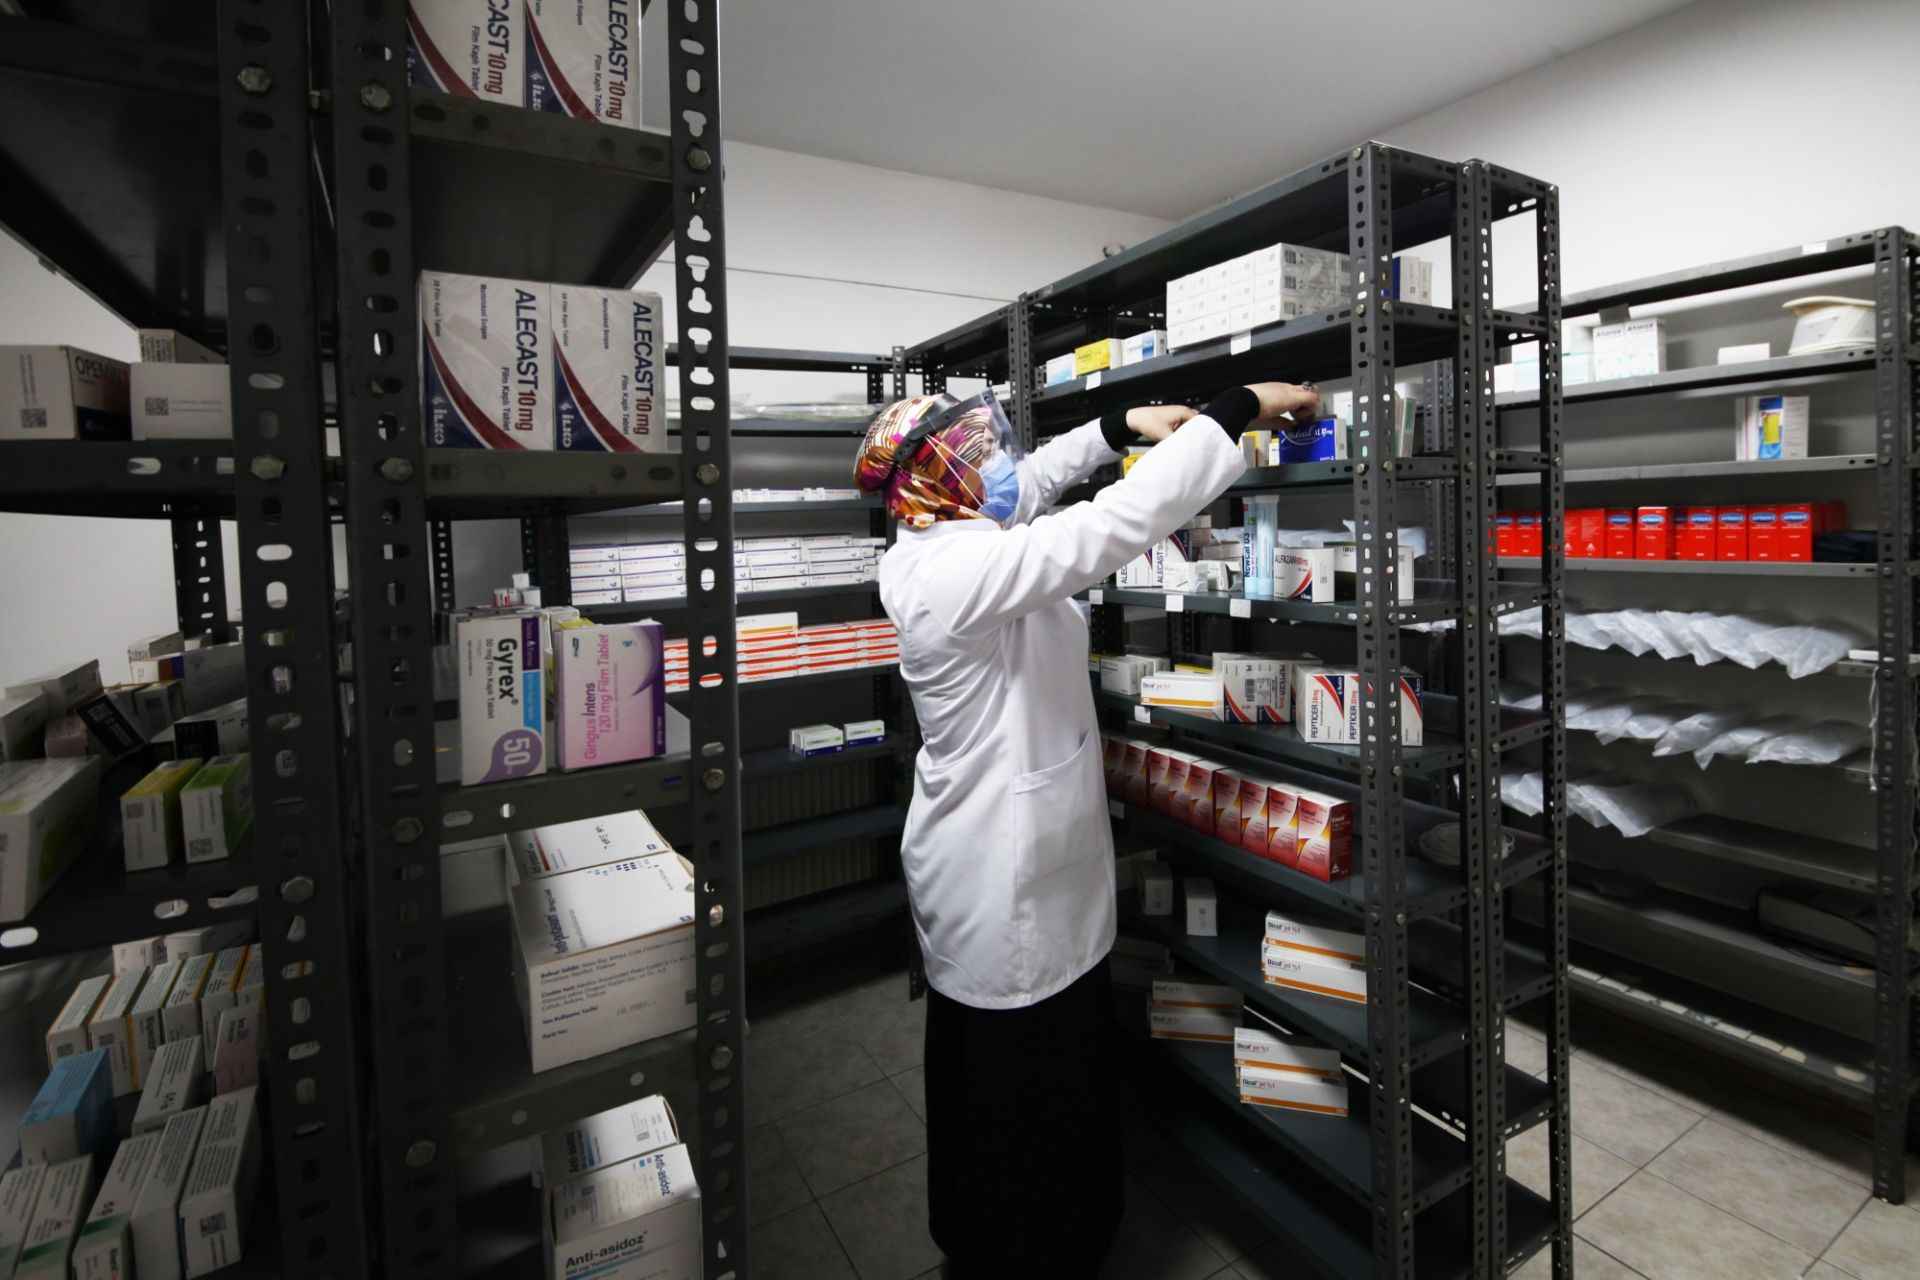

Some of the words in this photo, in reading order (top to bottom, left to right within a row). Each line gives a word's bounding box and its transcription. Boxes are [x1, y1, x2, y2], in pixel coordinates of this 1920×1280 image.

[514, 288, 538, 390] ALECAST
[632, 301, 654, 396] ALECAST
[501, 366, 510, 383] Film
[501, 406, 511, 431] Tablet
[596, 634, 610, 666] Tablet
[493, 638, 518, 700] Gyrex
[598, 668, 609, 694] Film
[580, 682, 597, 717] Intens
[599, 694, 613, 714] mg
[503, 736, 531, 767] 50
[565, 1233, 646, 1268] Anti-asidoz
